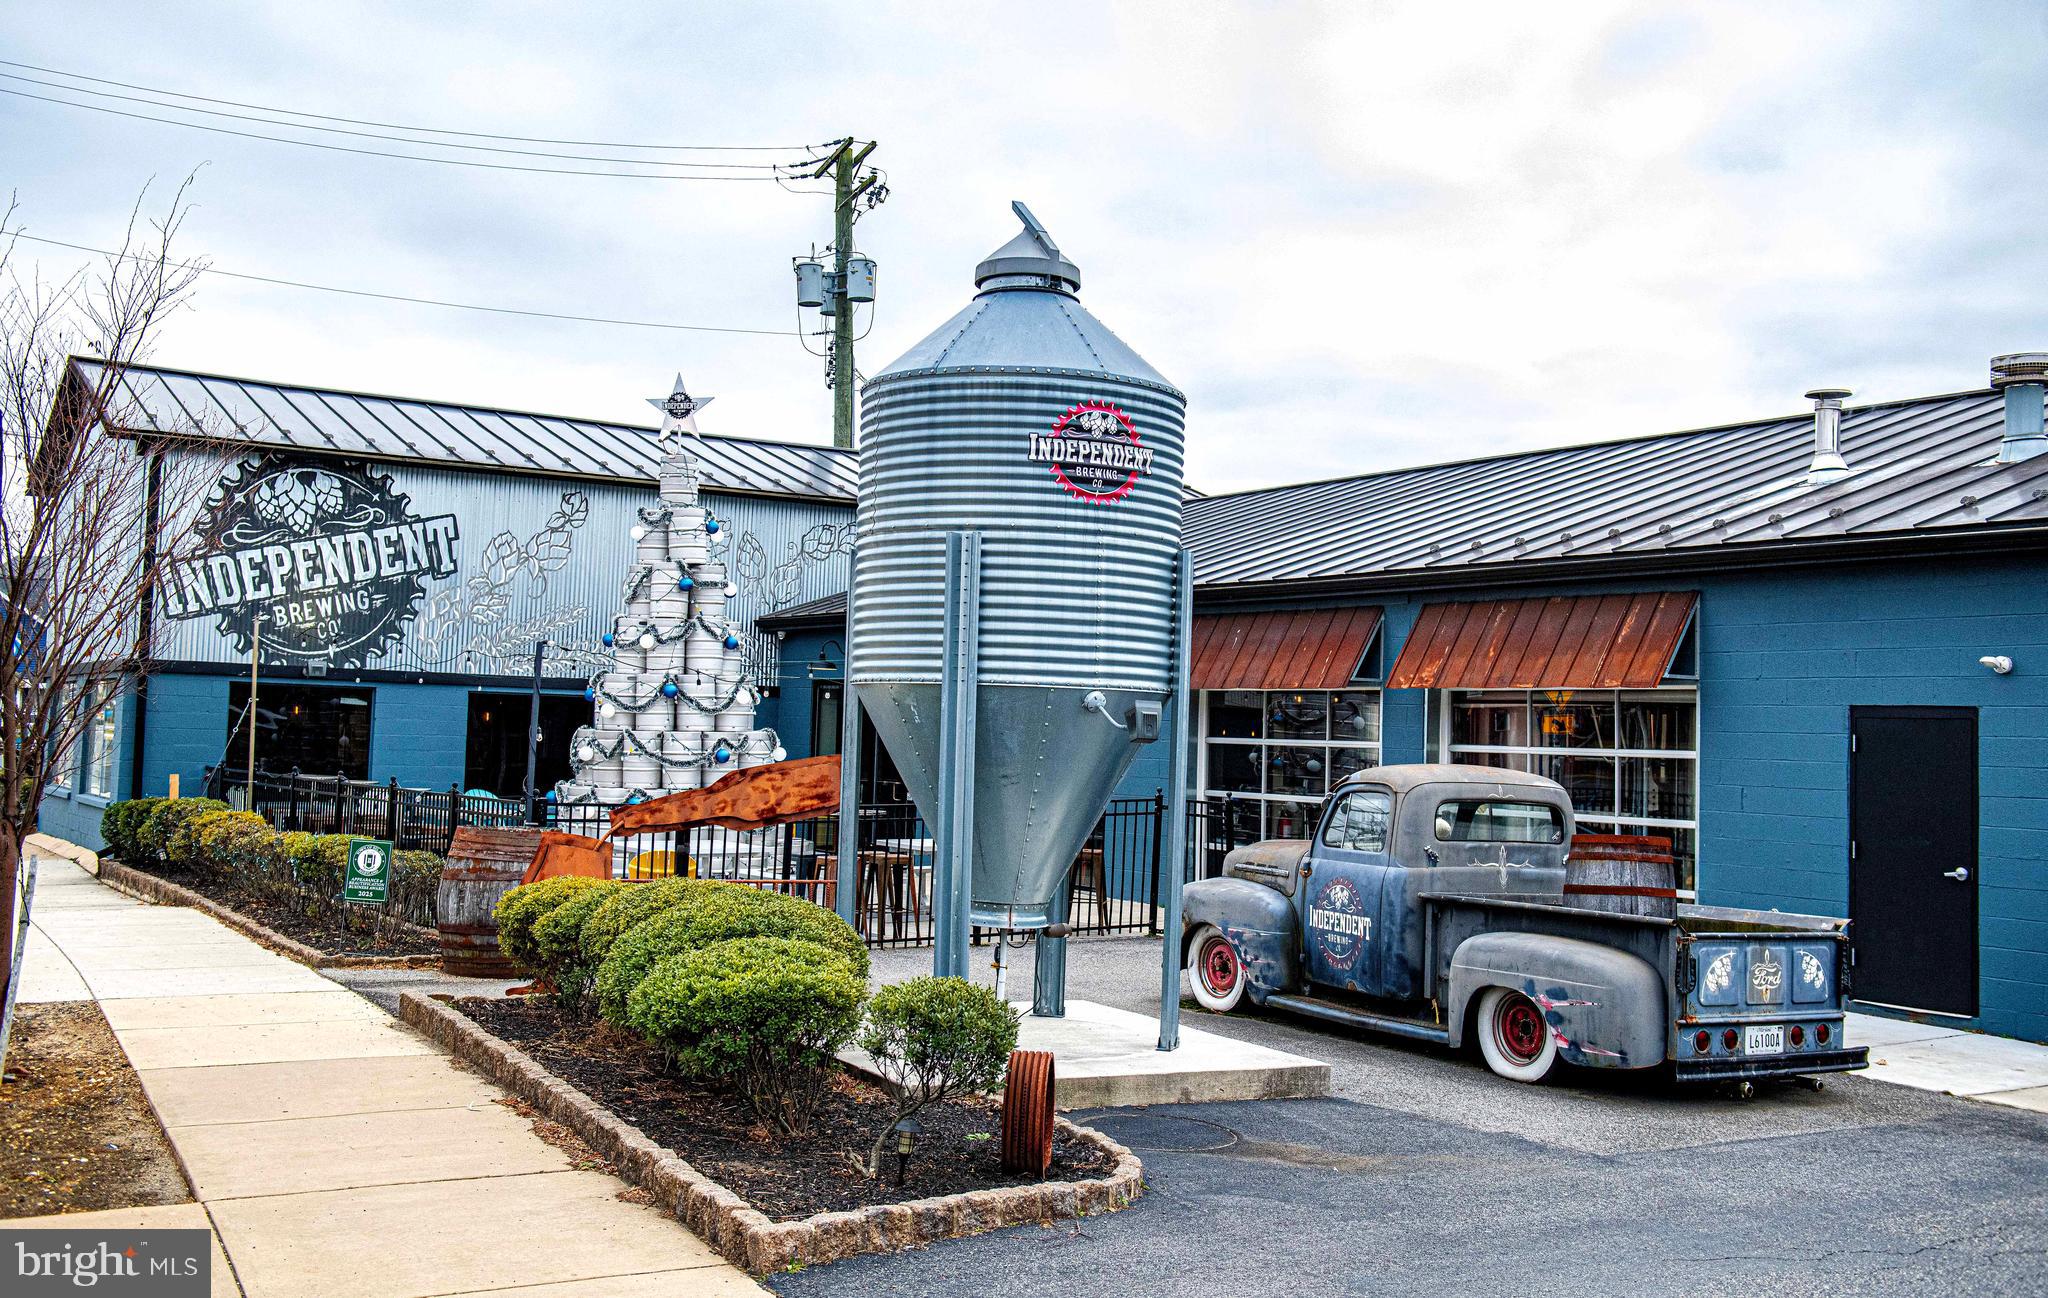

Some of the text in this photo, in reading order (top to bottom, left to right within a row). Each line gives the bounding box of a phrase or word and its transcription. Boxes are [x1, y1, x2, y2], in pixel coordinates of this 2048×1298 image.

[1028, 433, 1154, 475] INDEPENDENT
[1076, 466, 1119, 480] BREWING
[160, 516, 457, 616] INDEPENDENT
[273, 590, 370, 627] BREWING
[1309, 904, 1372, 941] INDEPENDENT
[1328, 934, 1348, 945] BREWING
[1752, 967, 1781, 985] Ford
[1749, 1033, 1780, 1049] L6100A
